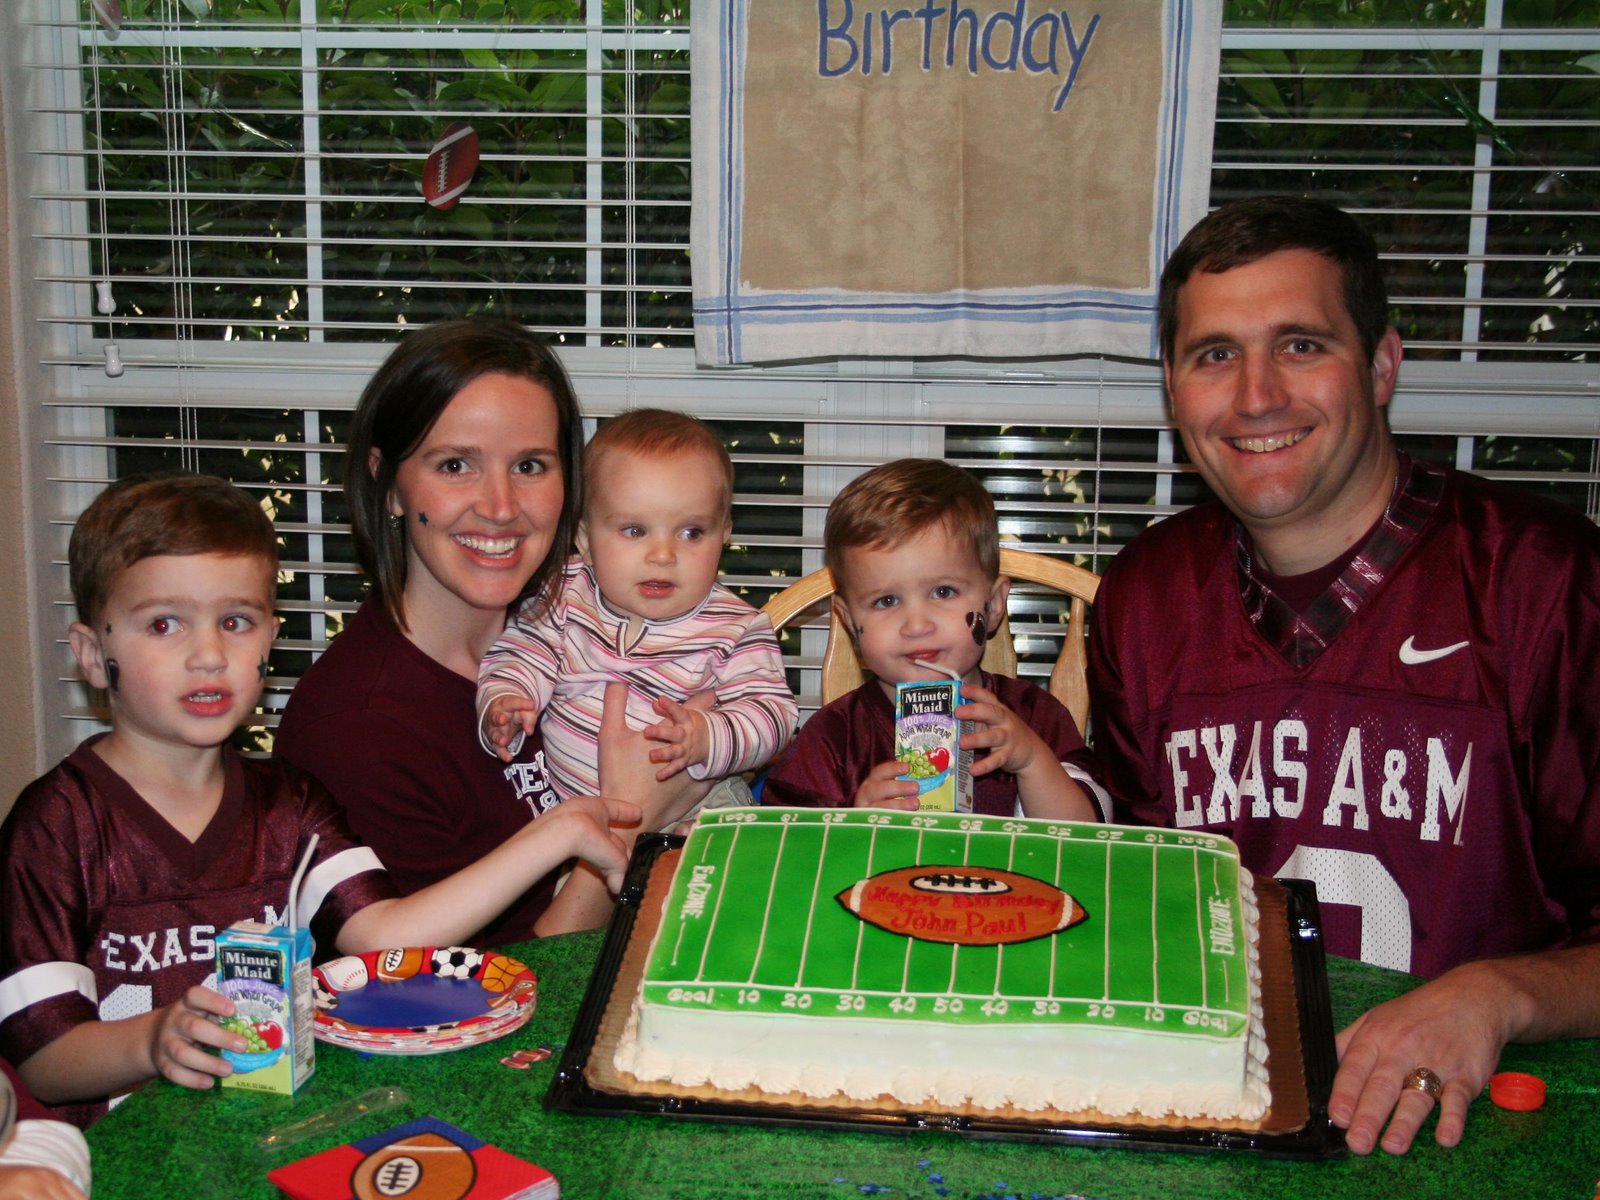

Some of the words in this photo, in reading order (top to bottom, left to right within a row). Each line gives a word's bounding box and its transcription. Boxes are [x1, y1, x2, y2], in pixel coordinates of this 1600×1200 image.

[818, 0, 1100, 112] Birthday
[905, 691, 949, 703] Minute
[911, 702, 942, 714] Maid
[1165, 719, 1308, 828] EXAS
[867, 886, 944, 909] Happy
[891, 907, 957, 933] John
[964, 911, 1027, 937] Paul
[101, 925, 216, 972] EXAS
[225, 951, 279, 968] Minute
[233, 965, 273, 980] Maid
[667, 988, 714, 1004] Goal
[738, 989, 761, 1004] 10
[781, 992, 812, 1008] 20
[836, 995, 866, 1011] 30
[889, 997, 917, 1013] 40
[933, 997, 963, 1013] 50
[981, 999, 1009, 1016] 40
[1086, 1003, 1116, 1019] 20
[1144, 1006, 1165, 1022] 10
[1183, 1010, 1229, 1031] Goal
